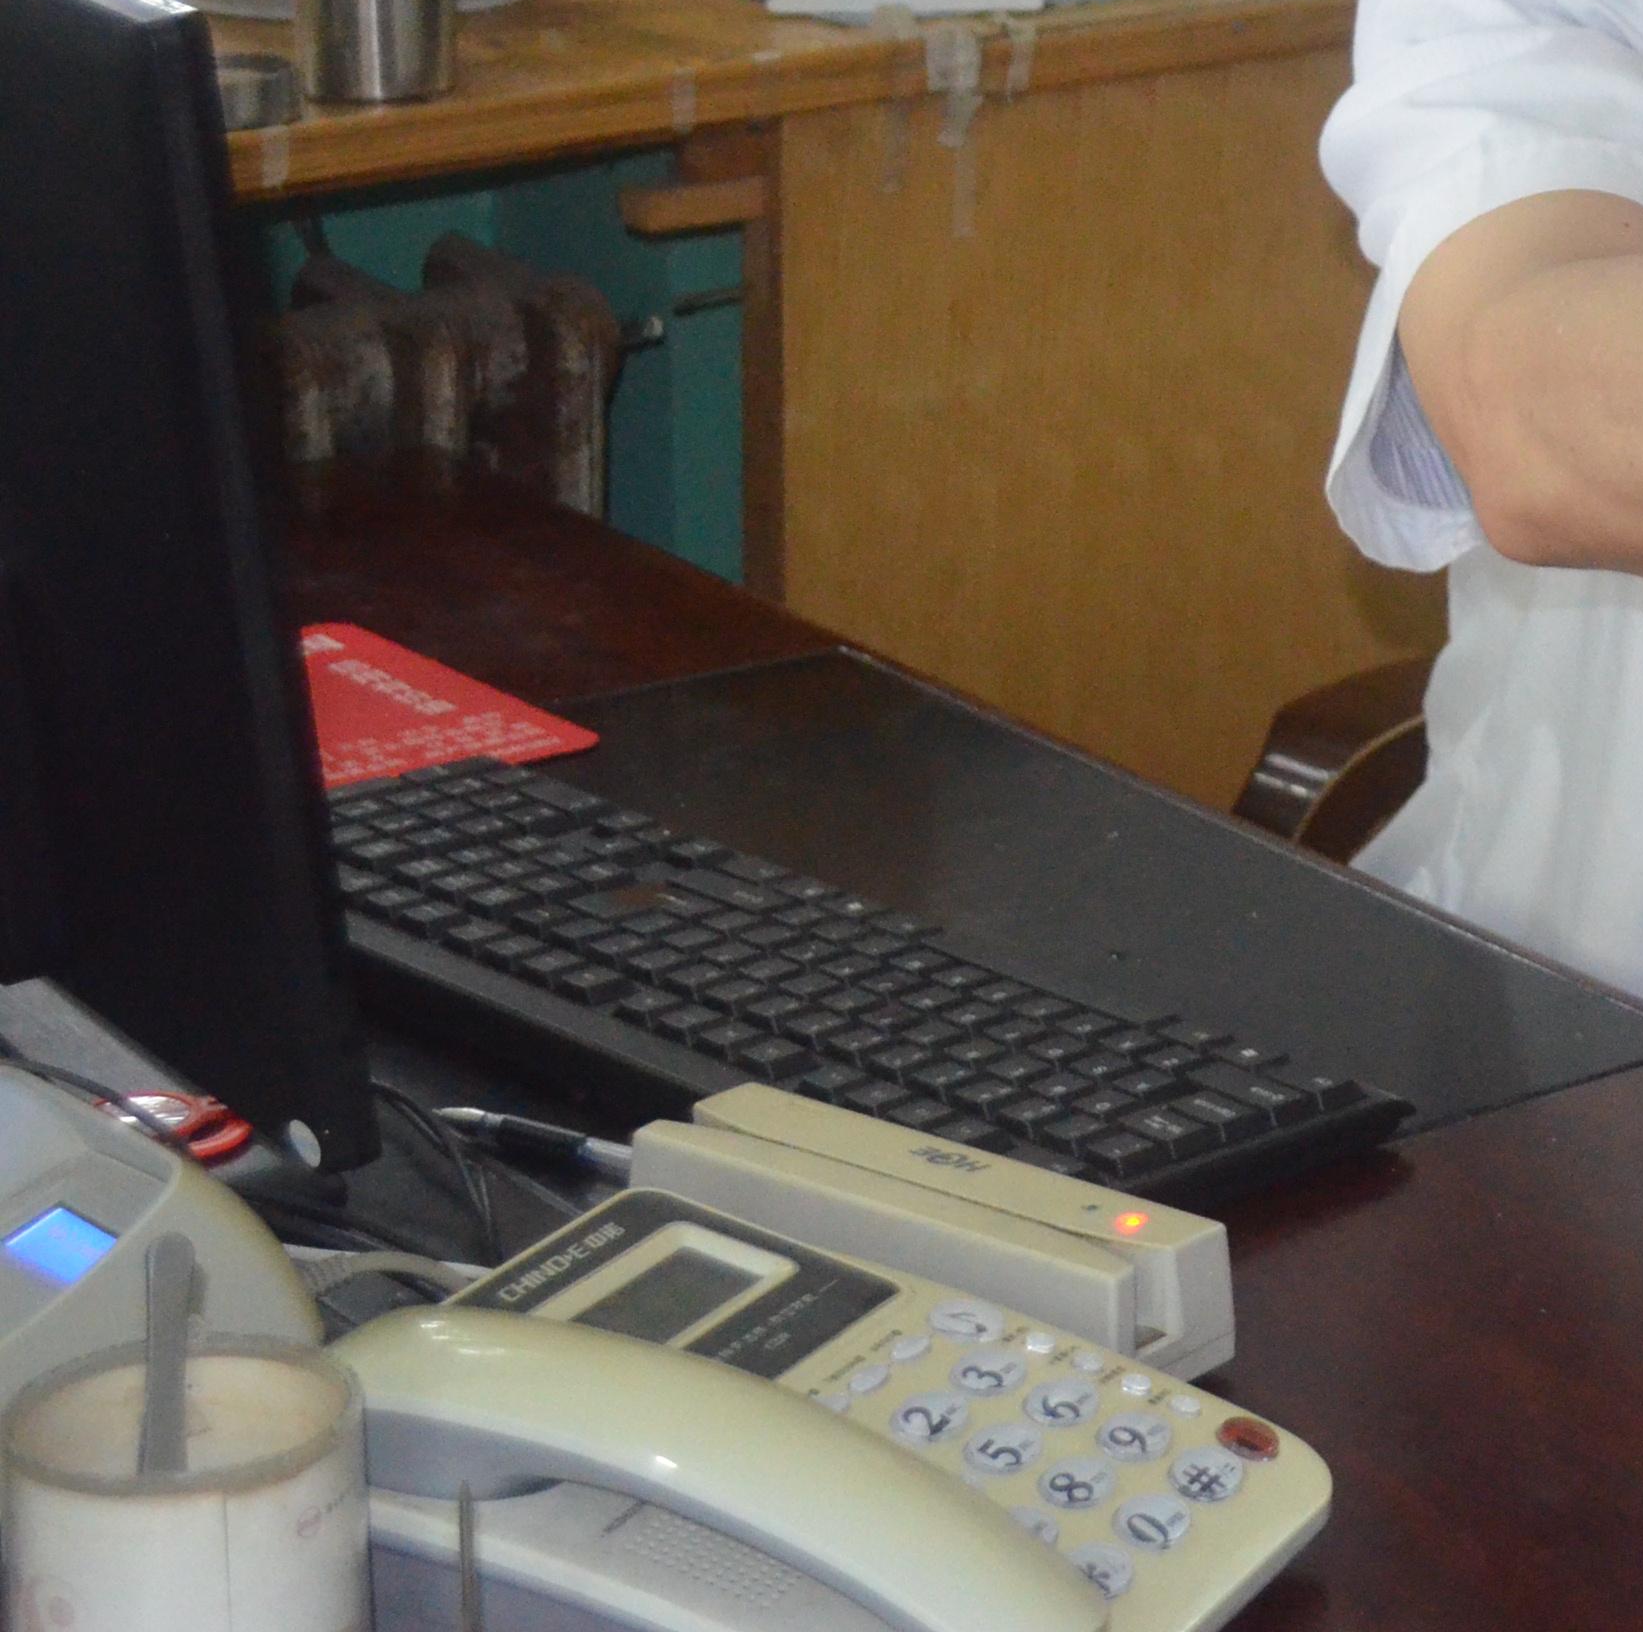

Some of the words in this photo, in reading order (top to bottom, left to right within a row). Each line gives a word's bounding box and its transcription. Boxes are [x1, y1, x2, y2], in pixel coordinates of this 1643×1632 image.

[961, 1365, 1005, 1389] 3
[1041, 1394, 1082, 1421] 6
[902, 1405, 952, 1441] 2
[977, 1438, 1023, 1468] 5
[1107, 1425, 1149, 1454] 9
[1048, 1471, 1095, 1504] 8
[1126, 1512, 1171, 1550] 0
